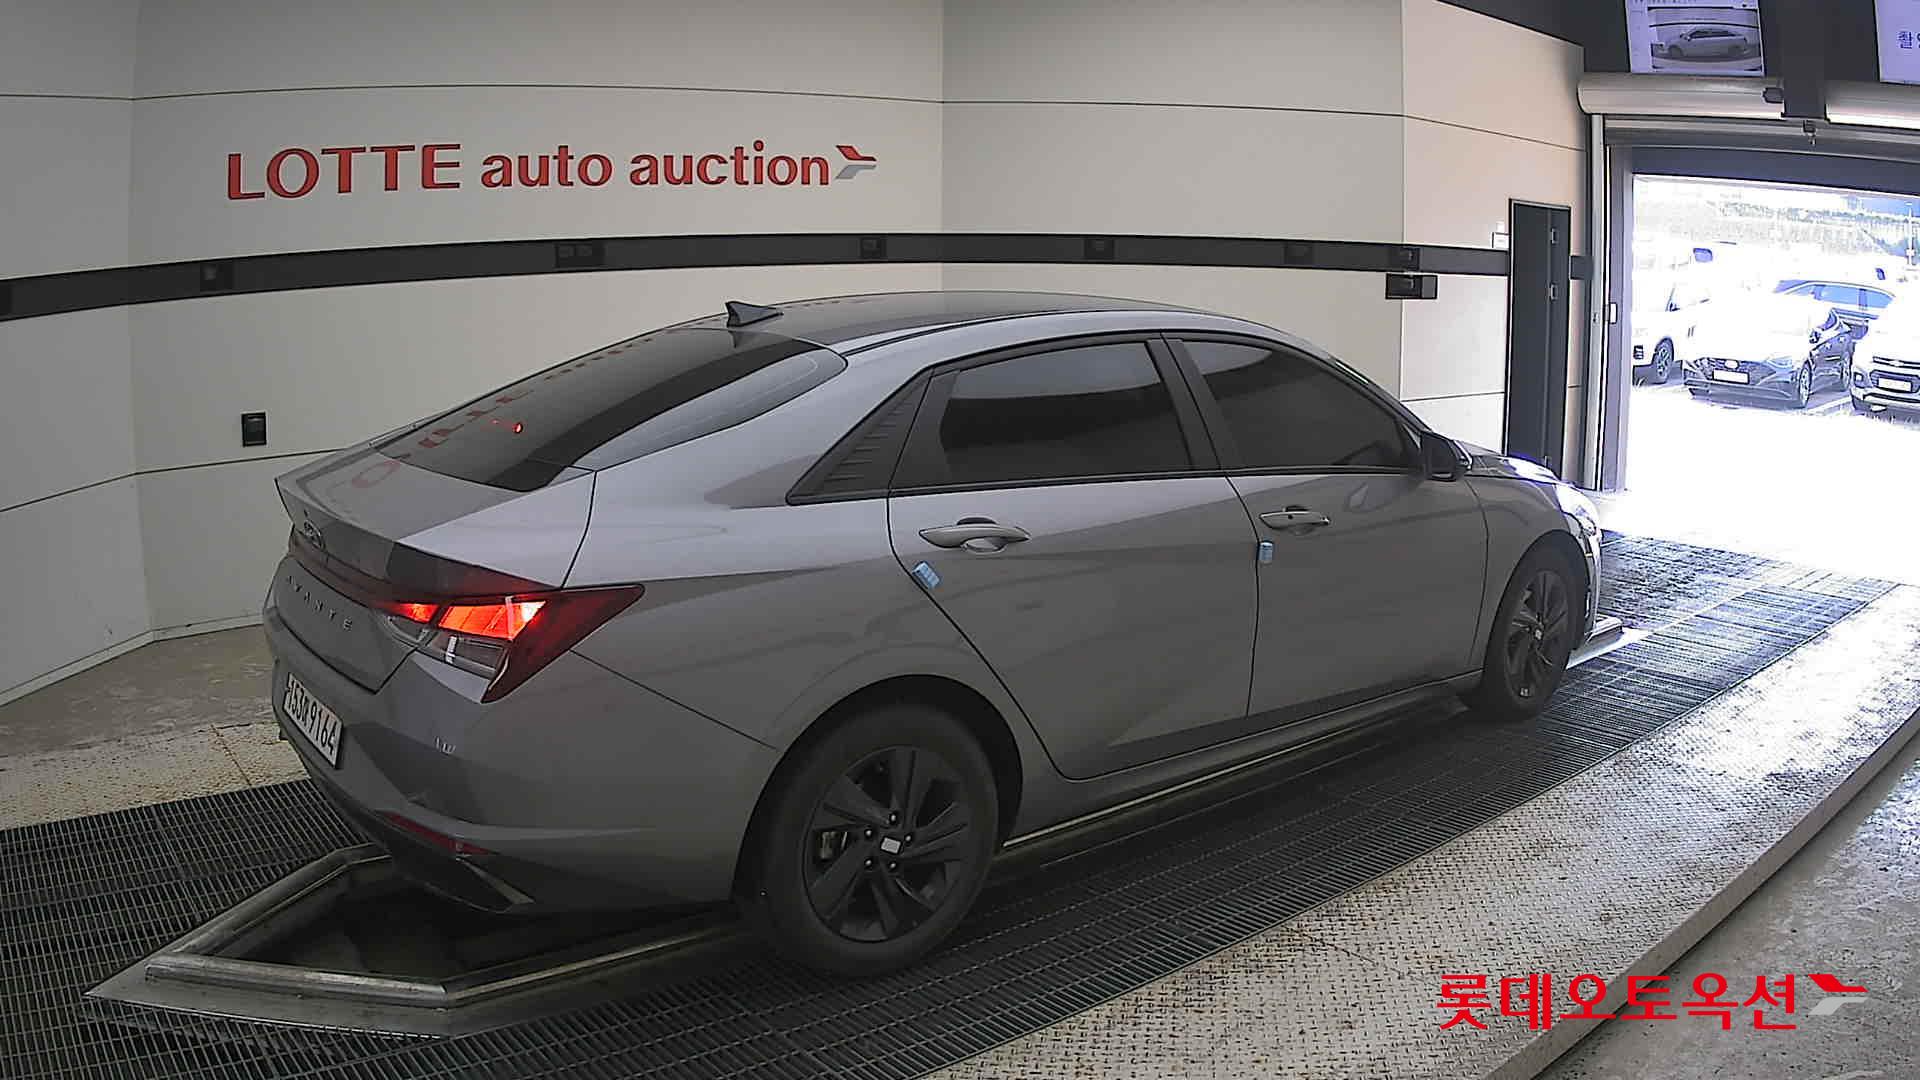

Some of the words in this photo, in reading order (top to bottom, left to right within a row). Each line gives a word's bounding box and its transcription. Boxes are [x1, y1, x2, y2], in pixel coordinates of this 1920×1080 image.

[1897, 31, 1920, 49] 촬
[227, 143, 461, 200] LOTTE
[481, 145, 612, 187] auto
[629, 140, 829, 185] auction
[309, 701, 338, 756] 9164
